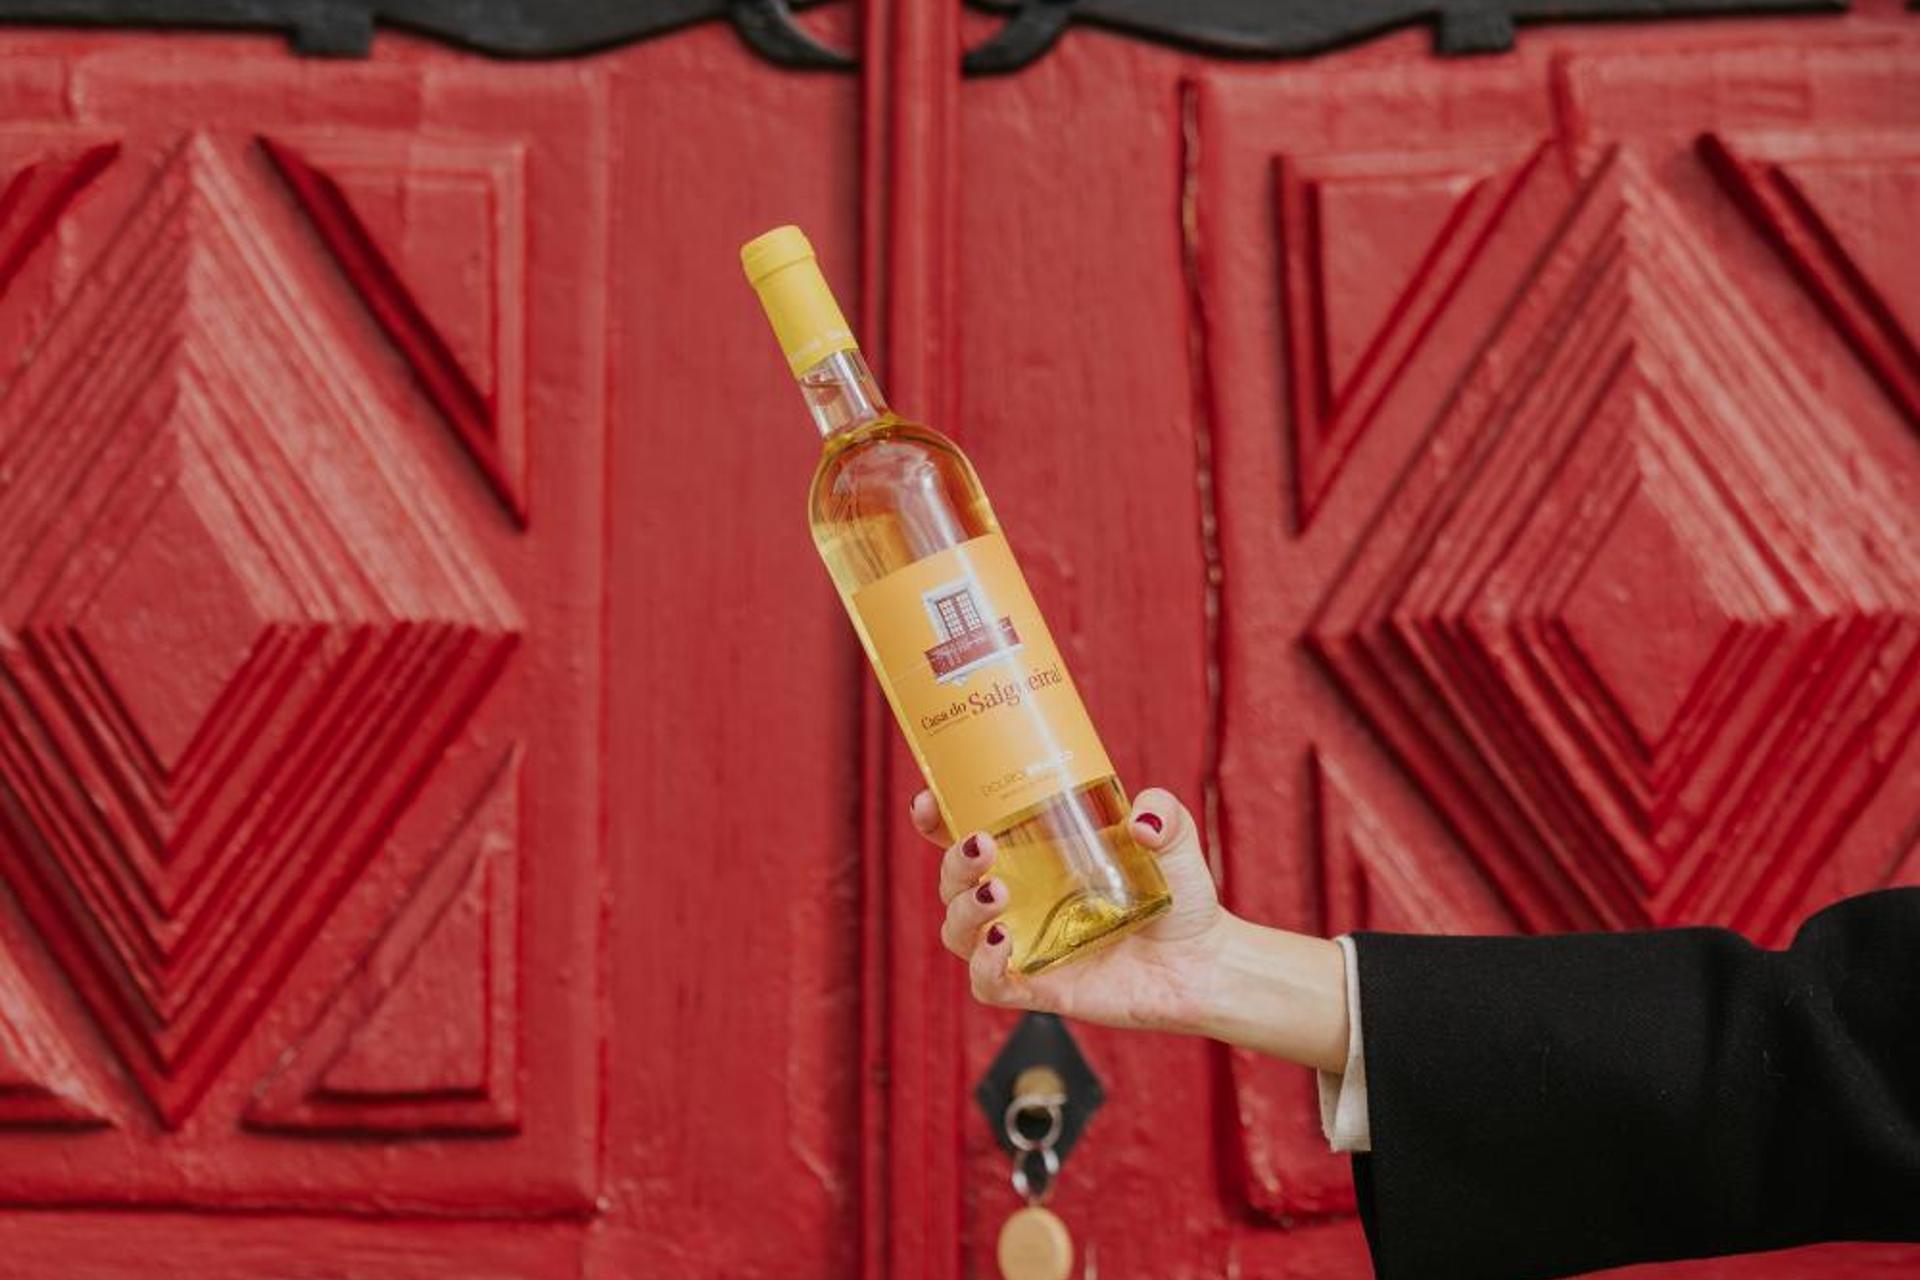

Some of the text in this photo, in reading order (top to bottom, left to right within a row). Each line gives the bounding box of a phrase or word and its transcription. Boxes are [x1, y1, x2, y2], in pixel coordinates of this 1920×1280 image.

[921, 664, 1062, 731] Casa do Salgeiral
